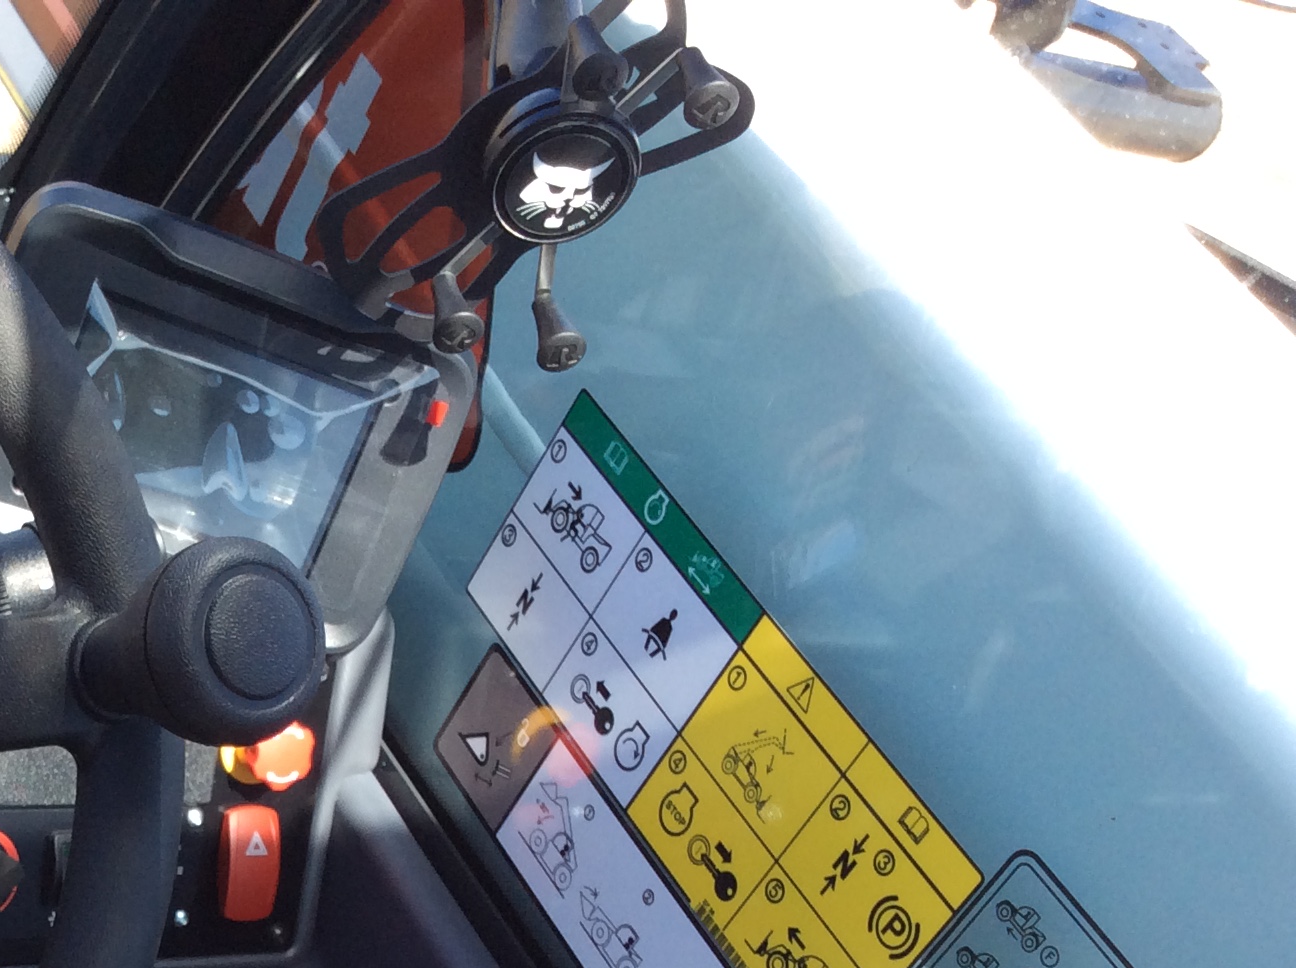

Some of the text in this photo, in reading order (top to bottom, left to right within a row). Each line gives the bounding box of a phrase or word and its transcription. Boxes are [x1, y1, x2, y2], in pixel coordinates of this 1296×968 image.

[516, 588, 535, 615] N
[665, 800, 686, 825] STOP
[832, 849, 857, 881] N
